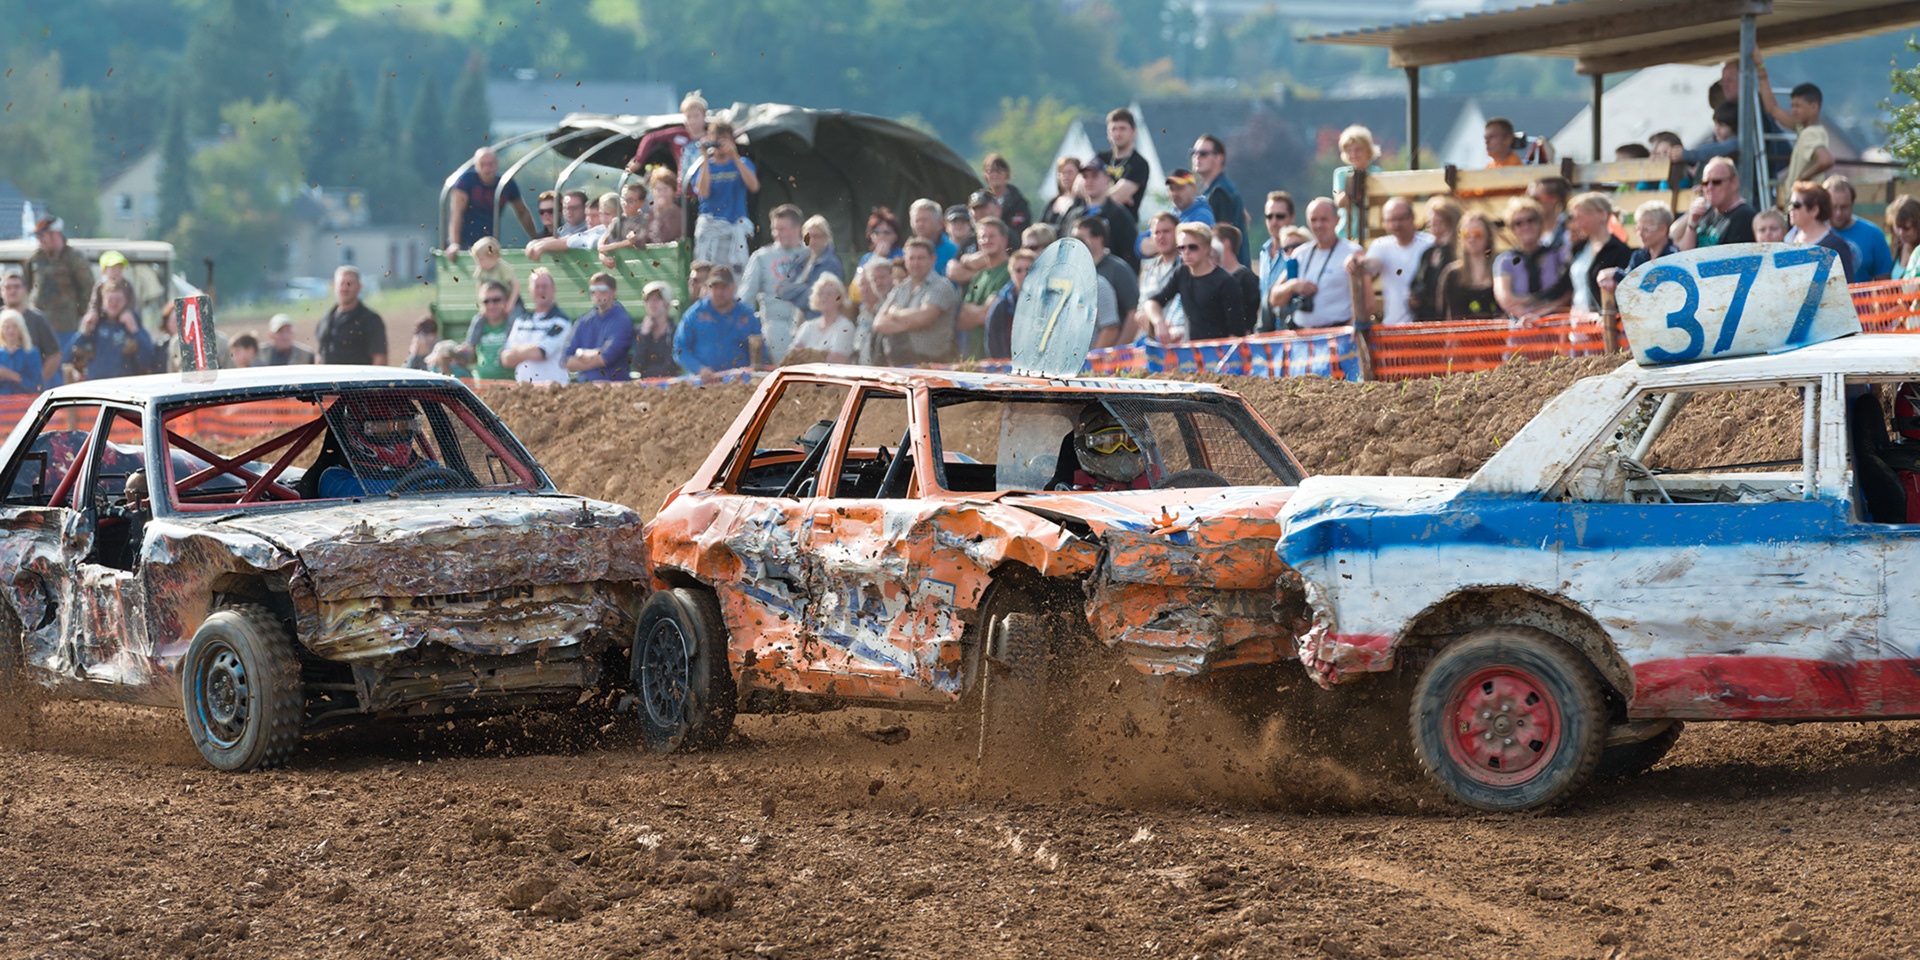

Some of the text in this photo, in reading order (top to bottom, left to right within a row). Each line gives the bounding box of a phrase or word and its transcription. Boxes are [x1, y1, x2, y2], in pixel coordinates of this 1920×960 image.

[183, 297, 206, 370] 1
[1039, 277, 1074, 353] 7
[1639, 246, 1838, 363] 377
